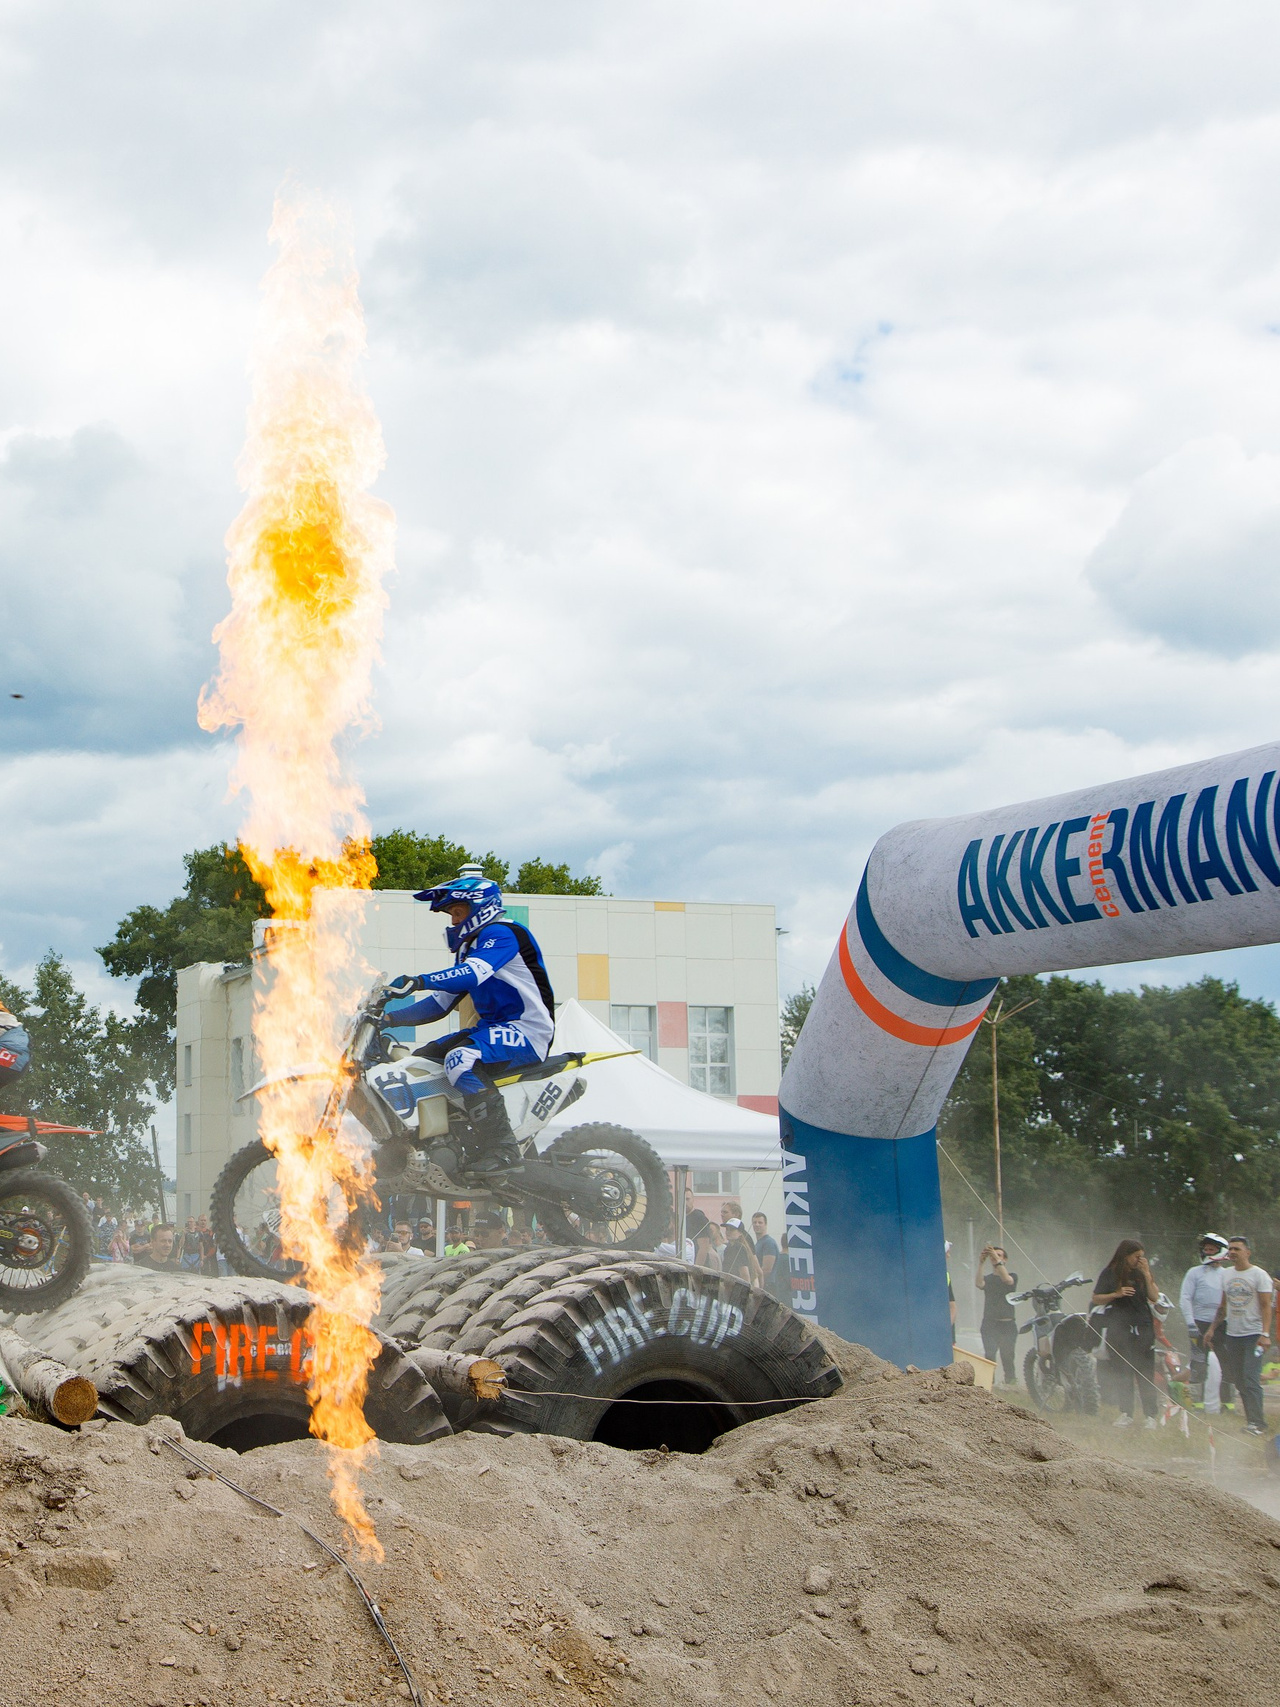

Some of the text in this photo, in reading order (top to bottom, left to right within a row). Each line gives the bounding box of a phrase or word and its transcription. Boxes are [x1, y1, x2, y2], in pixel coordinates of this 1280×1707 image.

[958, 770, 1280, 938] AKKERMAN
[1087, 810, 1120, 918] cement
[430, 965, 472, 982] DELICATE
[489, 1028, 526, 1047] FOX
[531, 1081, 563, 1122] 555
[668, 1287, 743, 1349] CUP
[191, 1323, 278, 1382] FIRE
